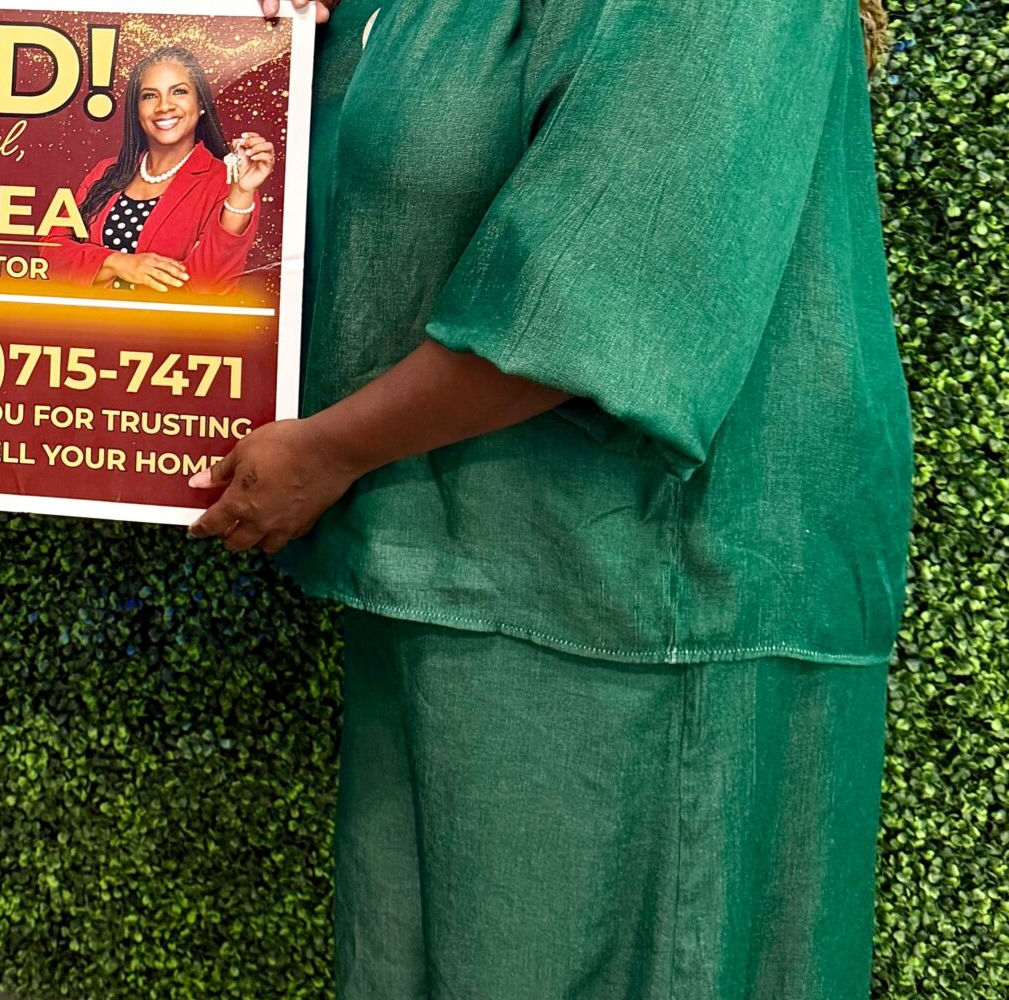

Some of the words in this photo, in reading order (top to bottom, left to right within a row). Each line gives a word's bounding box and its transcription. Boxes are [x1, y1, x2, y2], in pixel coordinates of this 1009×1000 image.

[33, 406, 95, 431] FOR
[101, 409, 253, 440] TRUSTING
[42, 444, 127, 472] YOUR
[135, 450, 225, 476] HOM
